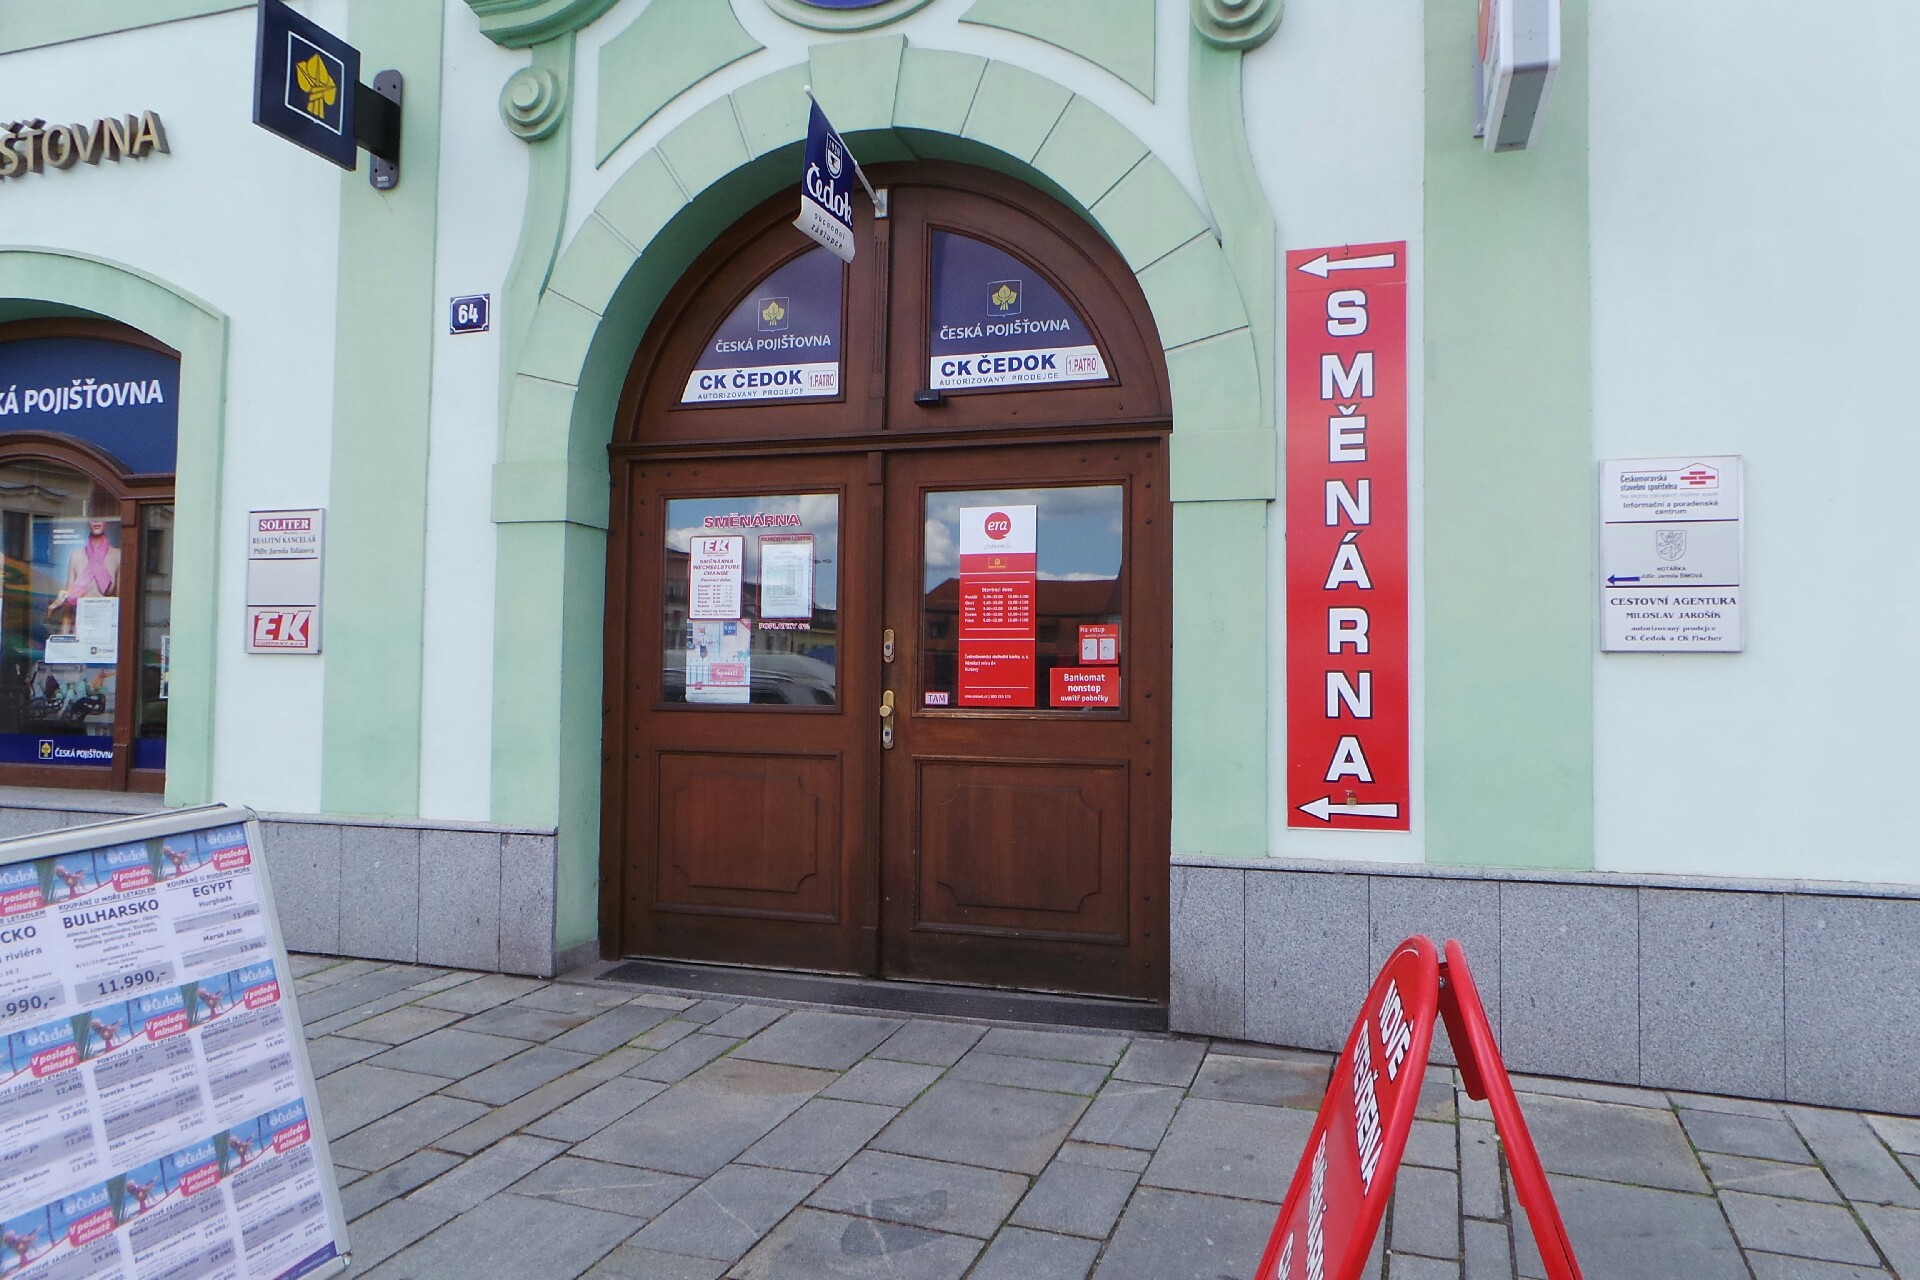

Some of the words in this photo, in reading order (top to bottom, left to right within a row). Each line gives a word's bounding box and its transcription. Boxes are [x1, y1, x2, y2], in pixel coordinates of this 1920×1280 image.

[807, 162, 852, 226] Čedok
[811, 223, 843, 249] zástupce
[458, 303, 479, 324] 64
[940, 323, 983, 340] ČESKÁ
[987, 319, 1070, 337] POJIŠŤOVNA
[716, 338, 753, 352] ČESKÁ
[757, 334, 831, 351] POJIŠŤOVNA
[941, 360, 972, 377] CK
[977, 355, 1056, 374] ČEDOK
[700, 374, 726, 390] CK
[733, 370, 802, 388] ČEDOK
[1012, 373, 1059, 381] PRODEJCE
[24, 378, 164, 415] POJIŠŤOVNA
[763, 388, 804, 396] PRODEJCE
[1620, 474, 1667, 483] Českomoravská
[260, 520, 309, 530] SOLITER
[704, 512, 801, 528] SMĚNÁRNA
[988, 521, 1007, 530] era
[1319, 287, 1375, 783] SMĚNÁRNA
[1611, 596, 1668, 605] CESTOVNÍ
[1673, 597, 1736, 605] AGENTURA
[1678, 611, 1721, 619] JAROŠÍK
[255, 610, 311, 640] EK
[1068, 685, 1101, 693] nonstop
[928, 694, 946, 703] TAM
[1082, 695, 1108, 703] pobočky
[55, 748, 75, 757] ČESKÁ
[4, 889, 41, 904] posledn
[192, 880, 232, 898] EGYPT
[199, 895, 233, 907] Hurghada
[62, 899, 159, 929] BULHARSKO
[6, 947, 42, 962] riviéra
[40, 1046, 76, 1065] posledn
